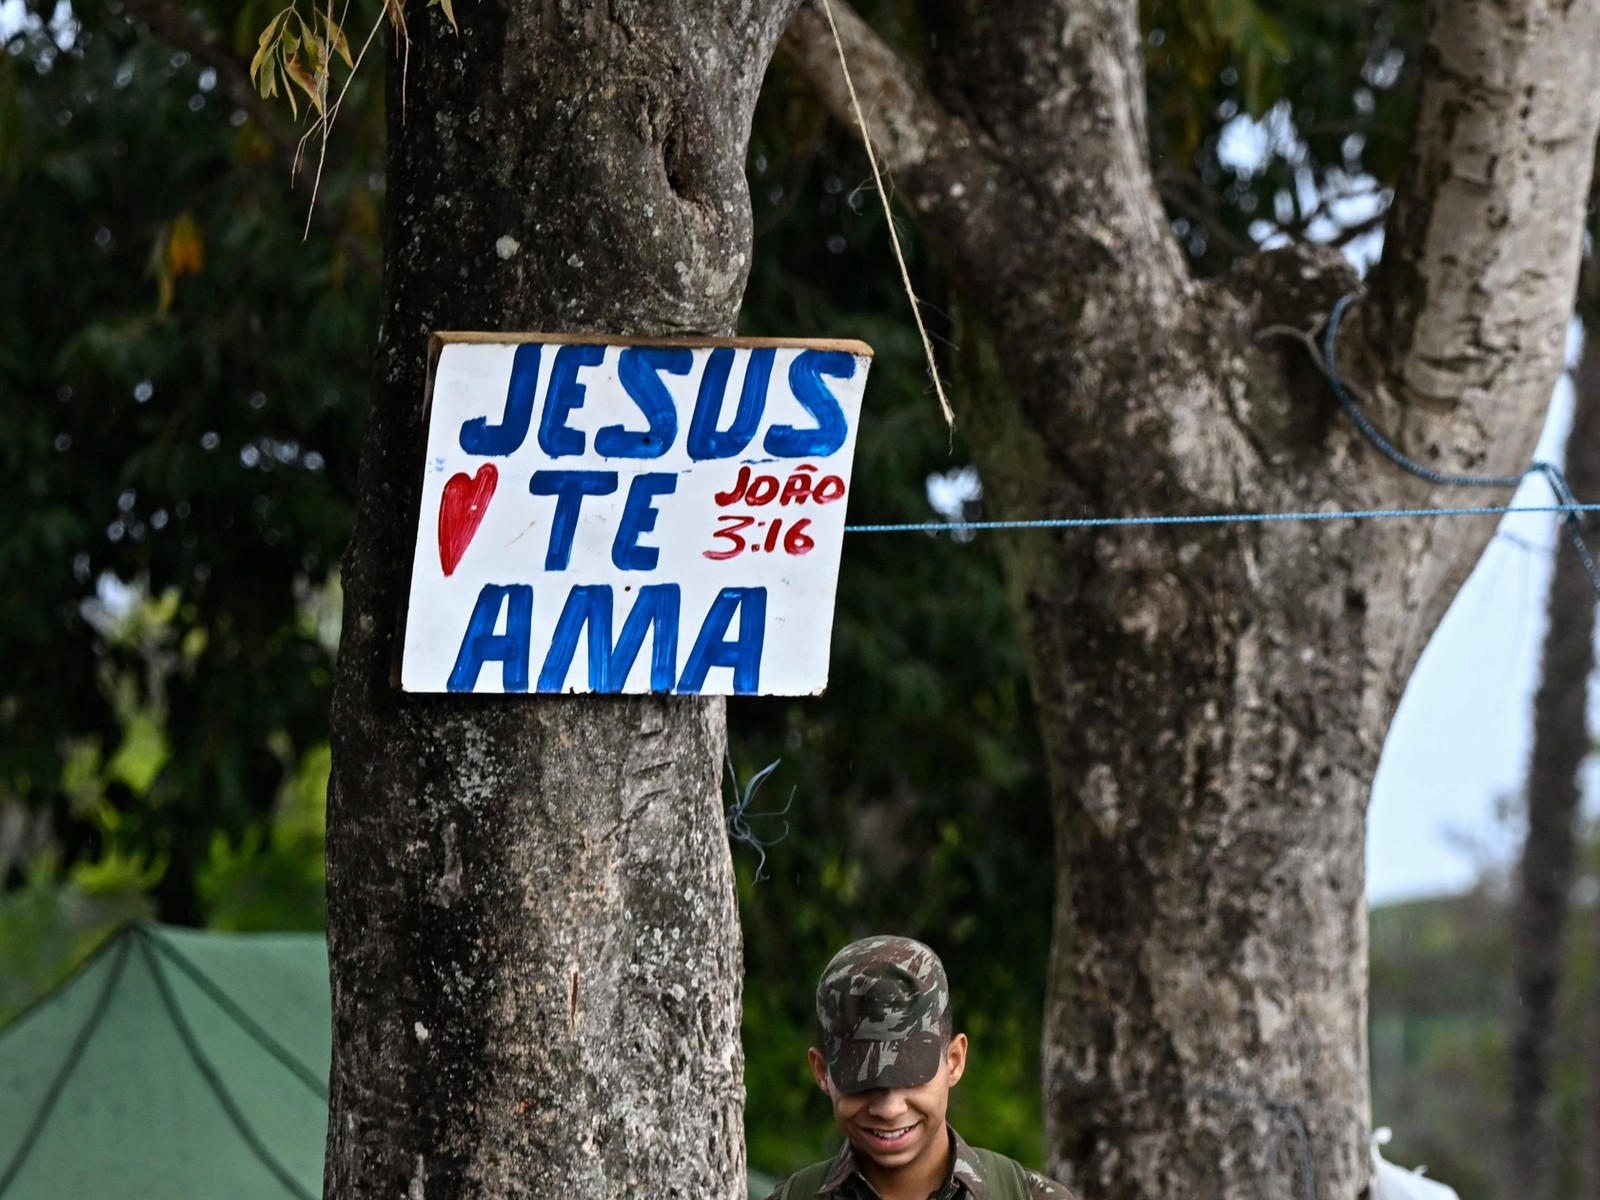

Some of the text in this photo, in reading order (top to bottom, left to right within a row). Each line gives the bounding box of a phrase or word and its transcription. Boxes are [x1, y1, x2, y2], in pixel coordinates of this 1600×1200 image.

[459, 343, 857, 461] JESUS
[529, 469, 679, 572] TE
[703, 515, 816, 561] 3:16
[446, 582, 768, 696] AMA
